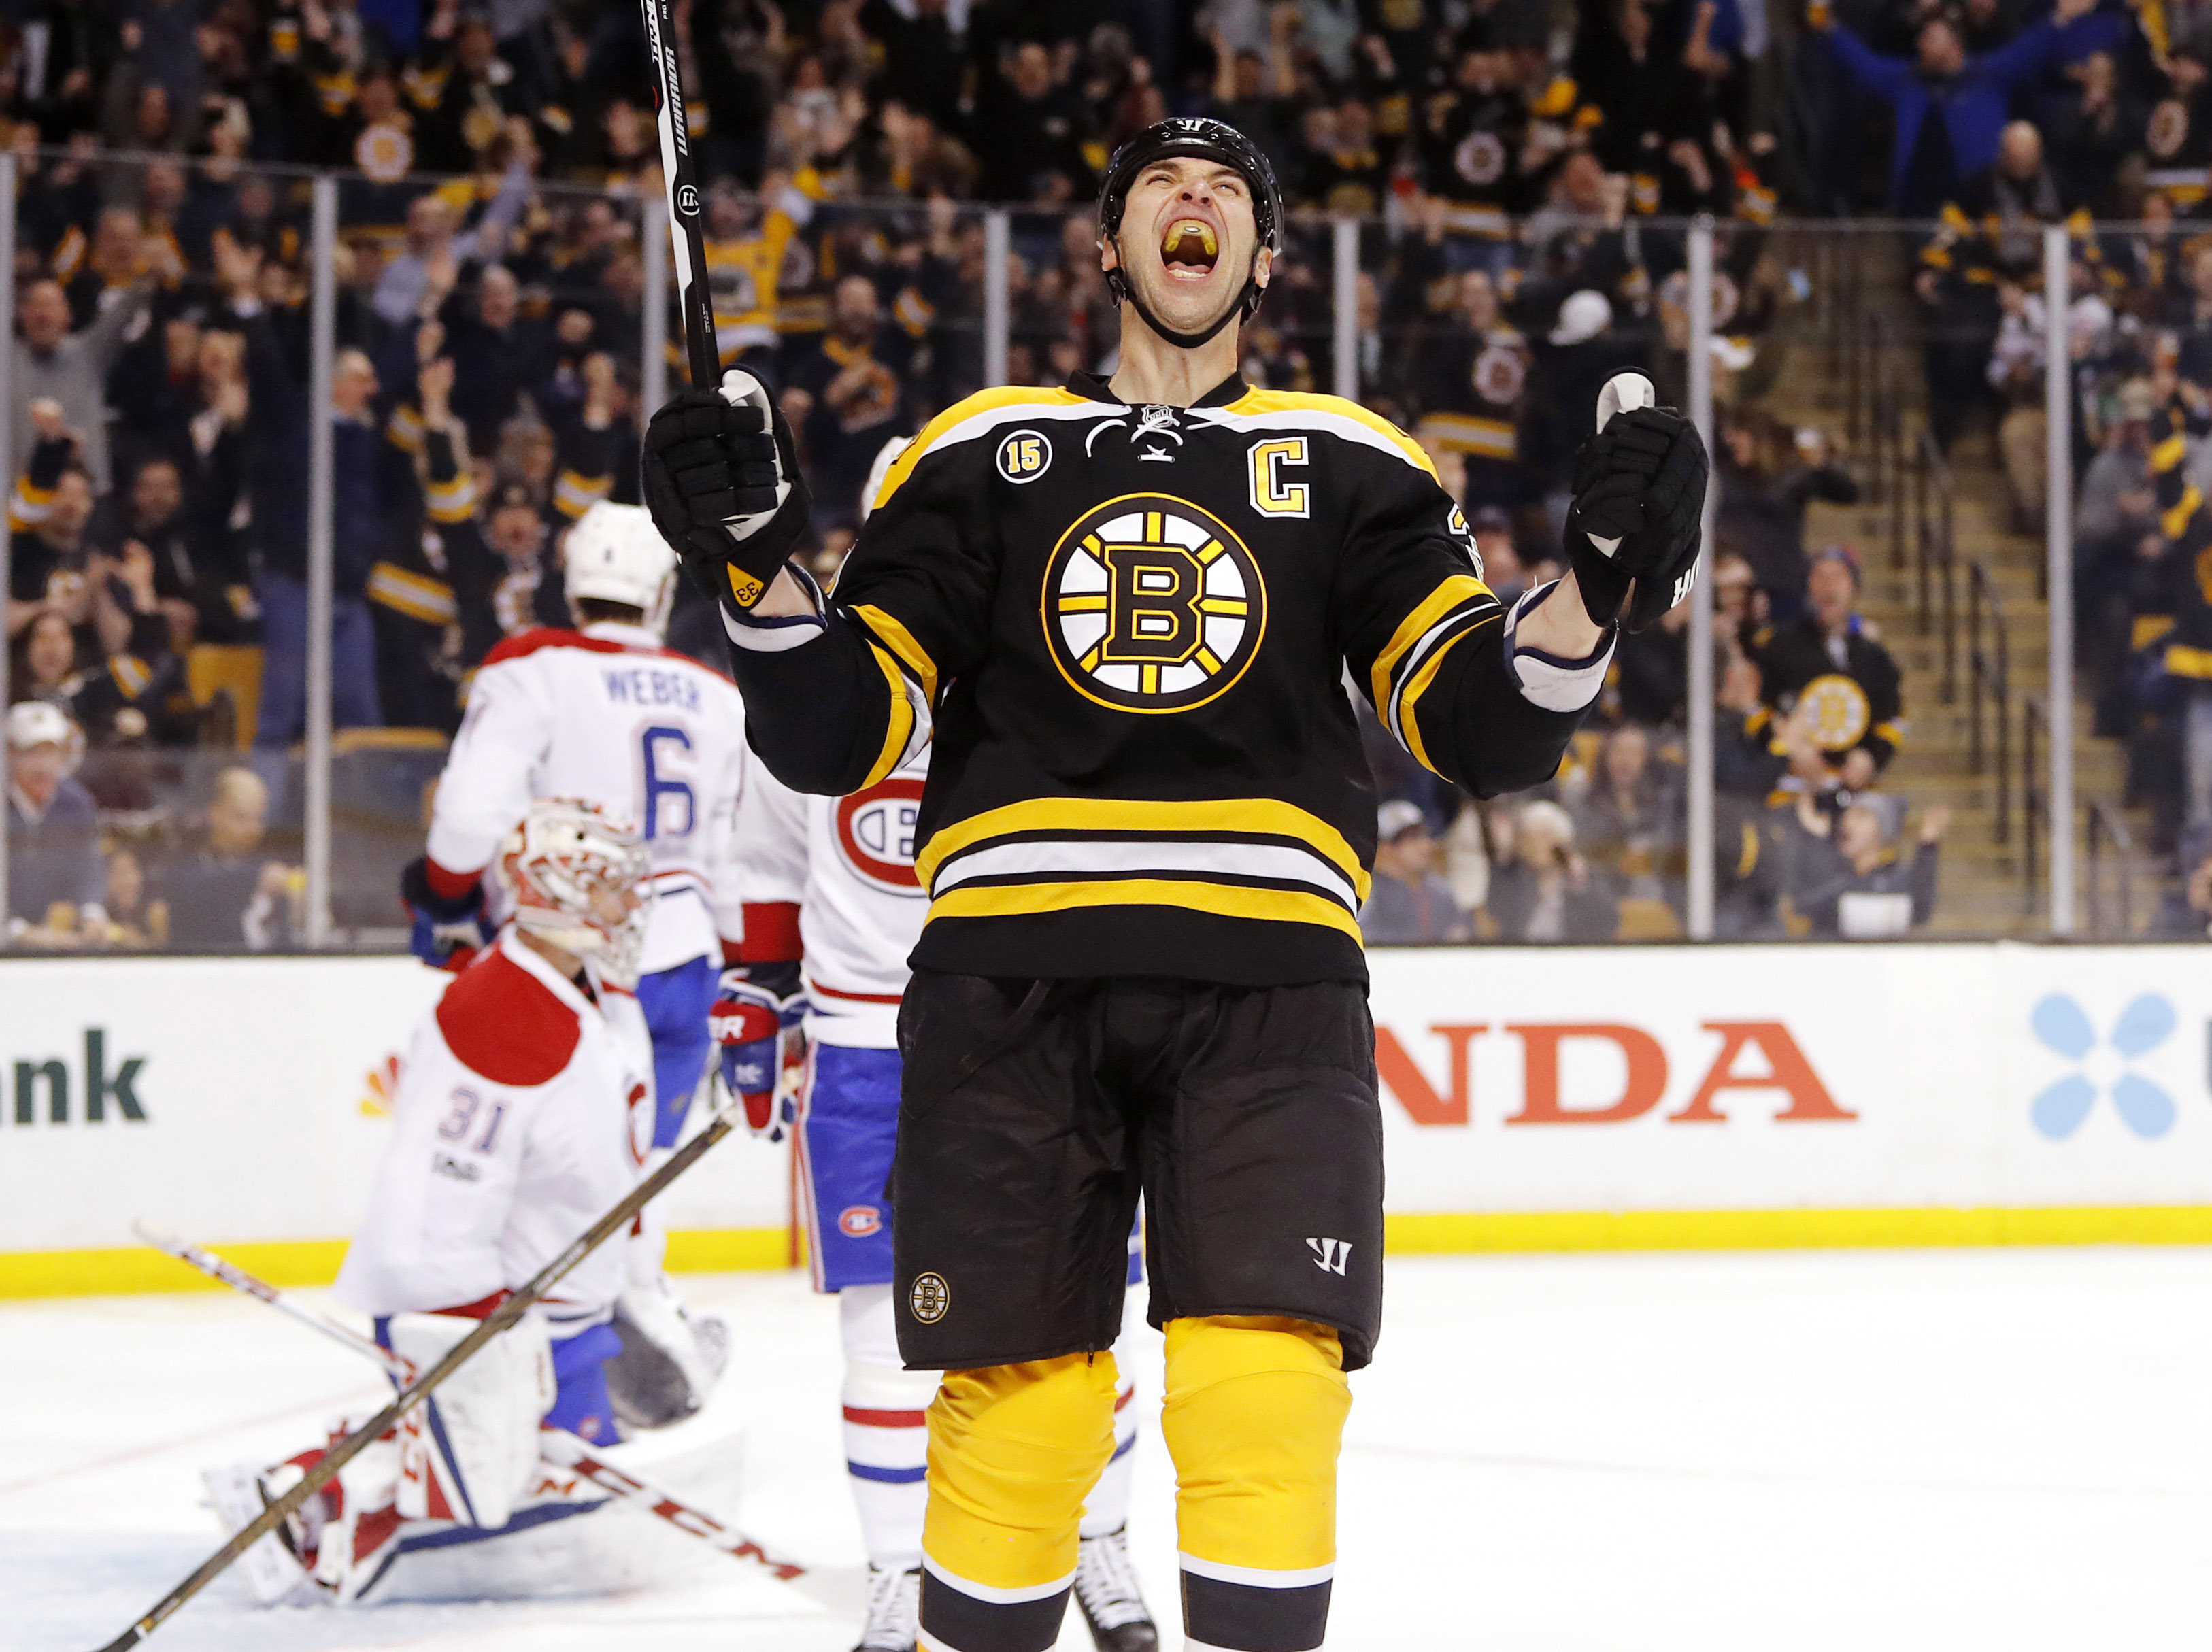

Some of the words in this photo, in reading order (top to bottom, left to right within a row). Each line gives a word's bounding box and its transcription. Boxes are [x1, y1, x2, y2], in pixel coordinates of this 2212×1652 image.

[665, 46, 688, 156] WARRIOR
[1007, 439, 1041, 473] 15
[1246, 436, 1310, 519] C
[736, 581, 760, 602] 33
[1102, 545, 1203, 663] B
[601, 668, 701, 713] WEBER
[639, 722, 696, 841] 6
[0, 1029, 146, 1124] nk
[1374, 1022, 1859, 1126] NDA
[435, 1086, 507, 1154] 31
